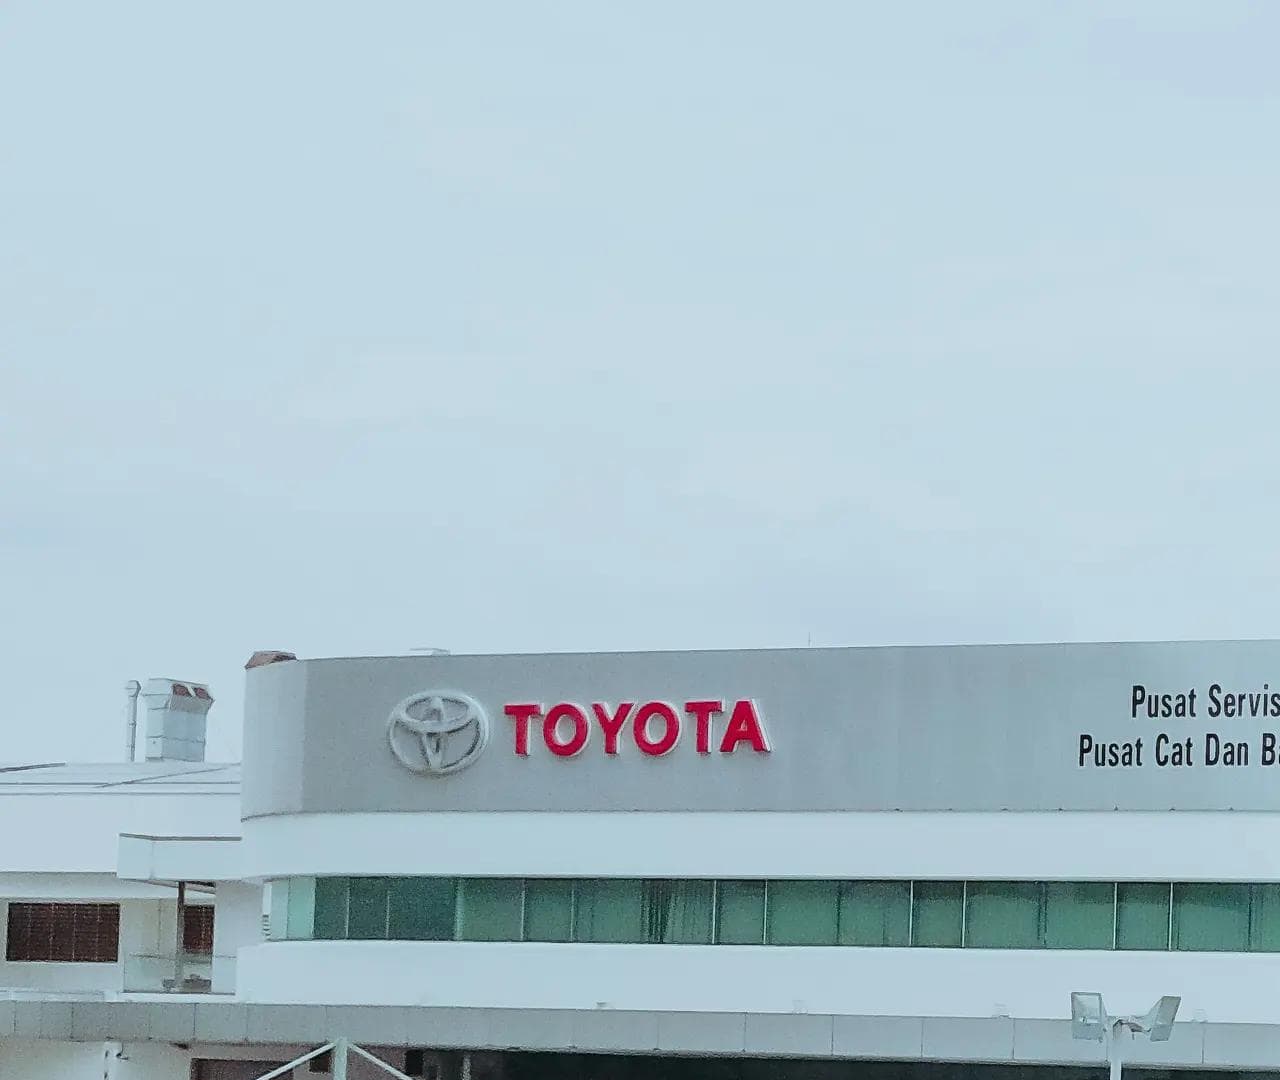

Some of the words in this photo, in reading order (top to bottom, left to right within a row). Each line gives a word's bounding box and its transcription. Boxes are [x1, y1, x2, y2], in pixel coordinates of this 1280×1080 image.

[1131, 684, 1197, 718] Pusat
[503, 699, 770, 757] TOYOTA
[1078, 734, 1144, 767] Pusat
[1155, 733, 1194, 767] Cat
[1205, 733, 1249, 767] Dan
